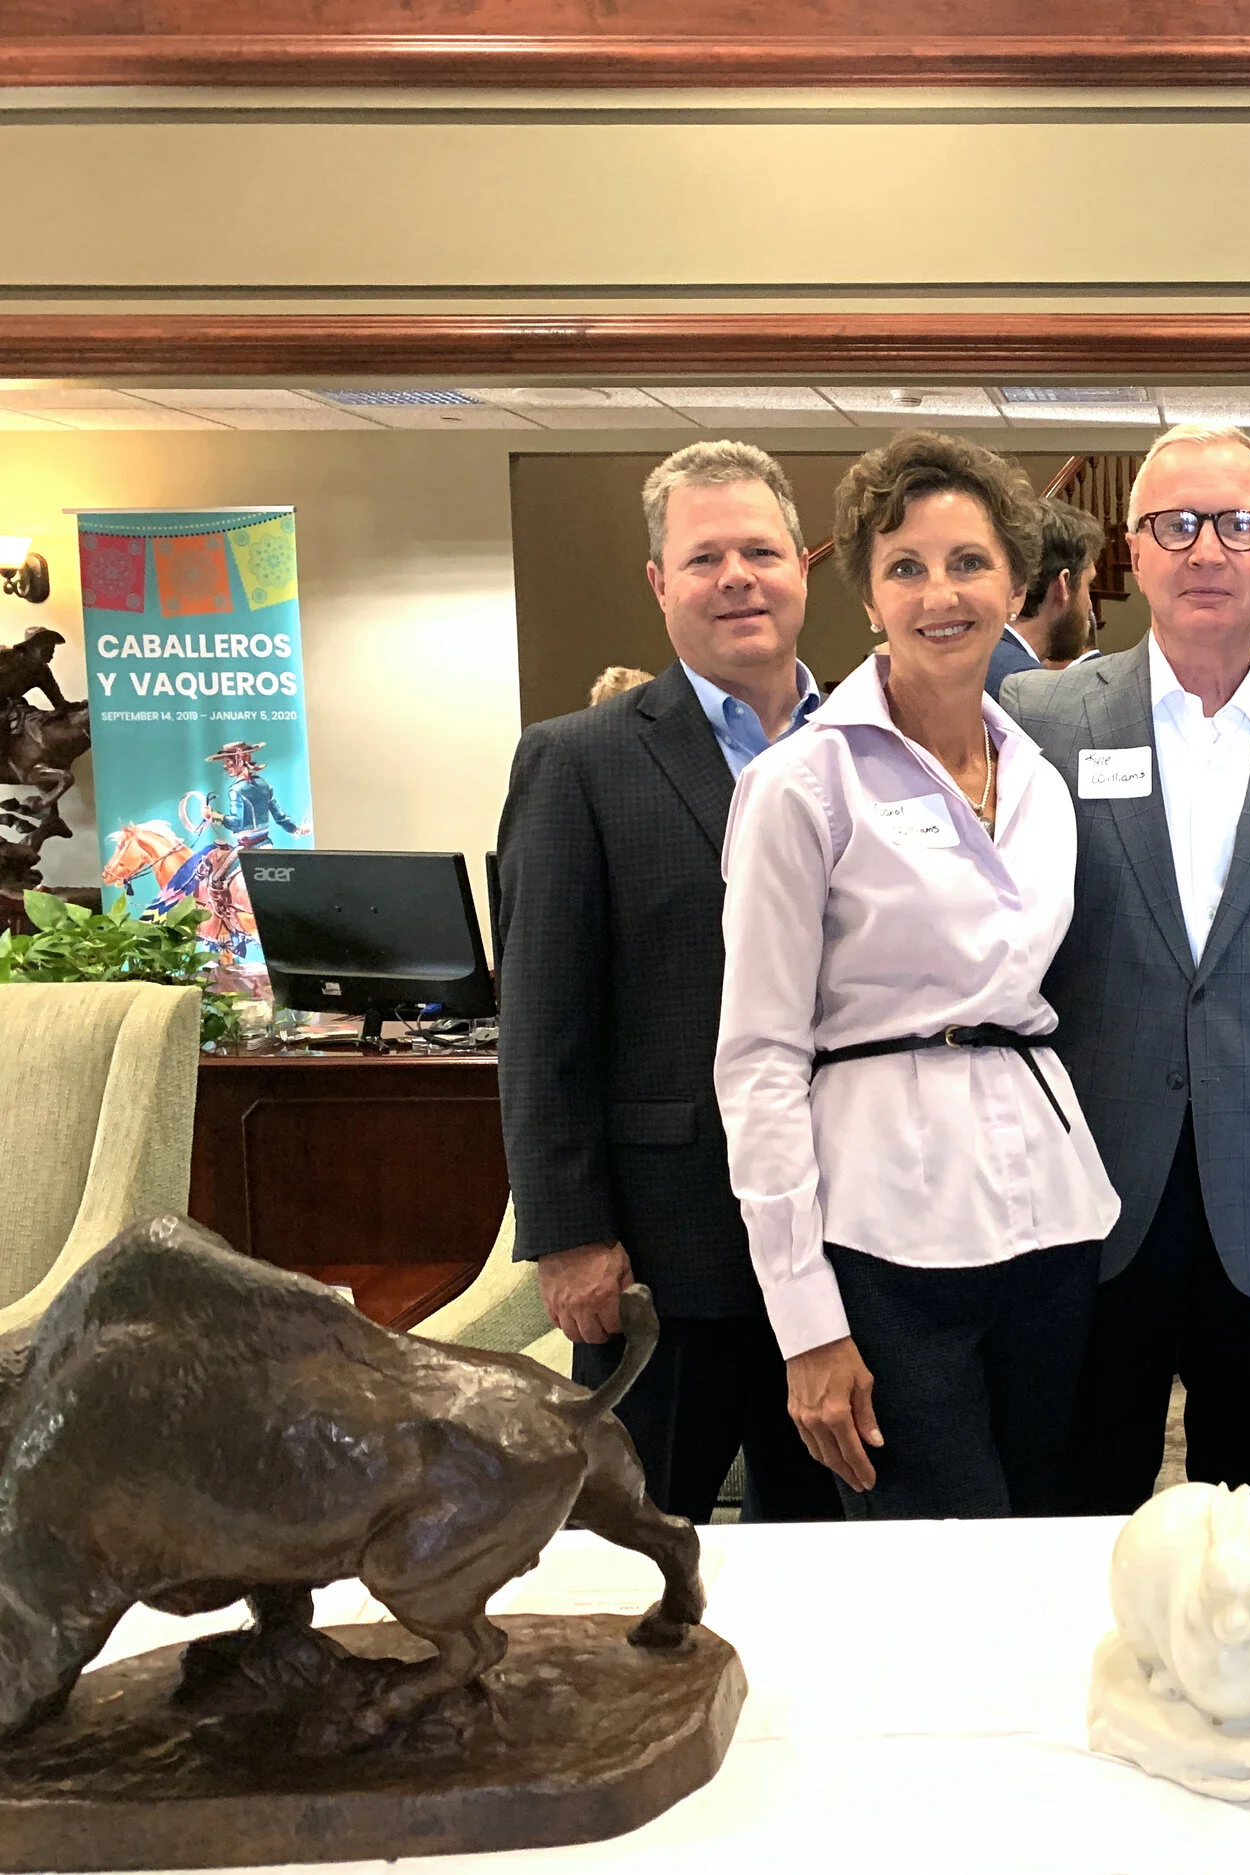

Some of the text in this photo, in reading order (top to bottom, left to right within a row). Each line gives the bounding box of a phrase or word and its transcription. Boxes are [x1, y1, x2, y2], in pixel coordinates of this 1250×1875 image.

[97, 633, 292, 658] CABALLEROS
[96, 671, 298, 699] Y VAQUEROS
[101, 712, 158, 721] SEPTEMBER
[160, 712, 174, 722] 14,
[176, 711, 198, 721] 2019
[210, 711, 257, 720] JANUARY
[260, 711, 270, 721] 5,
[271, 711, 298, 721] 2020
[1091, 773, 1146, 784] Williams
[253, 867, 296, 881] acer
